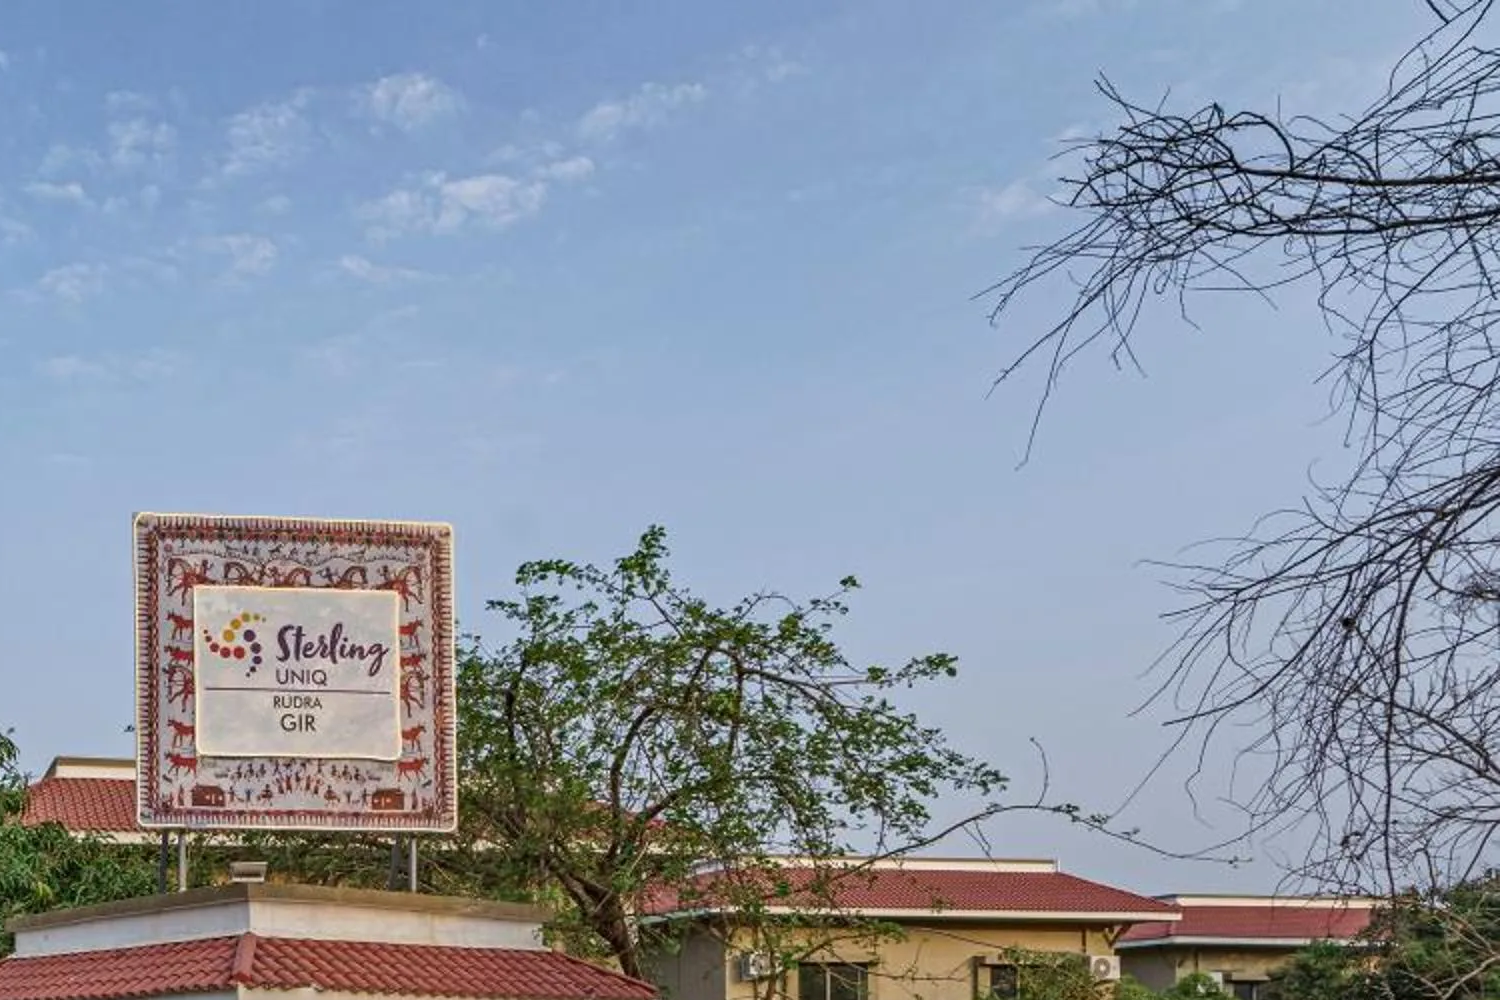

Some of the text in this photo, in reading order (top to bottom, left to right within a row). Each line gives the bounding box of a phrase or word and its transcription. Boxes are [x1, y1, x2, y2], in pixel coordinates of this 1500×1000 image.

[276, 623, 389, 677] Sterling
[276, 669, 328, 687] UNIQ
[273, 695, 323, 710] RUDRA
[280, 713, 316, 732] GIR
